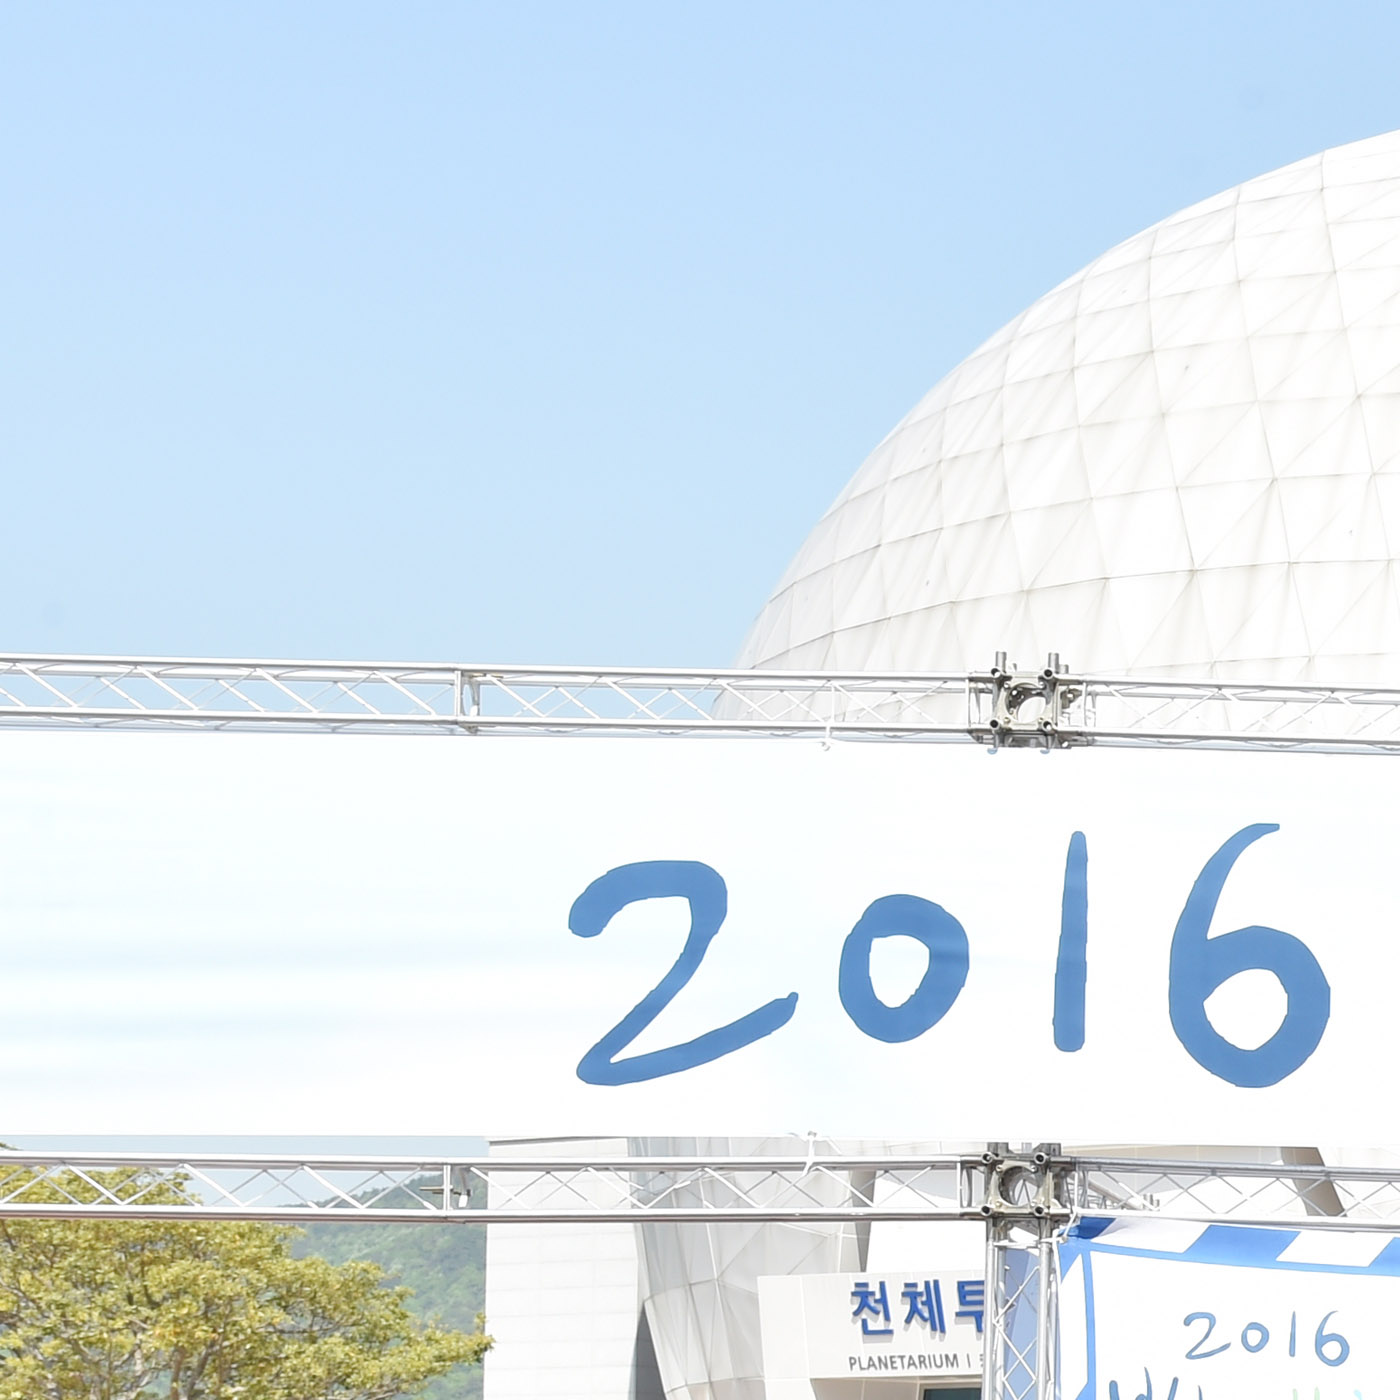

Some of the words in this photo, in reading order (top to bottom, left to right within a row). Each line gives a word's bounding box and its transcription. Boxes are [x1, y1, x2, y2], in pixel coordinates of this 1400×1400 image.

[569, 824, 1330, 1088] 2016
[849, 1354, 959, 1371] PLANETARIUM
[1183, 1310, 1350, 1367] 2016
